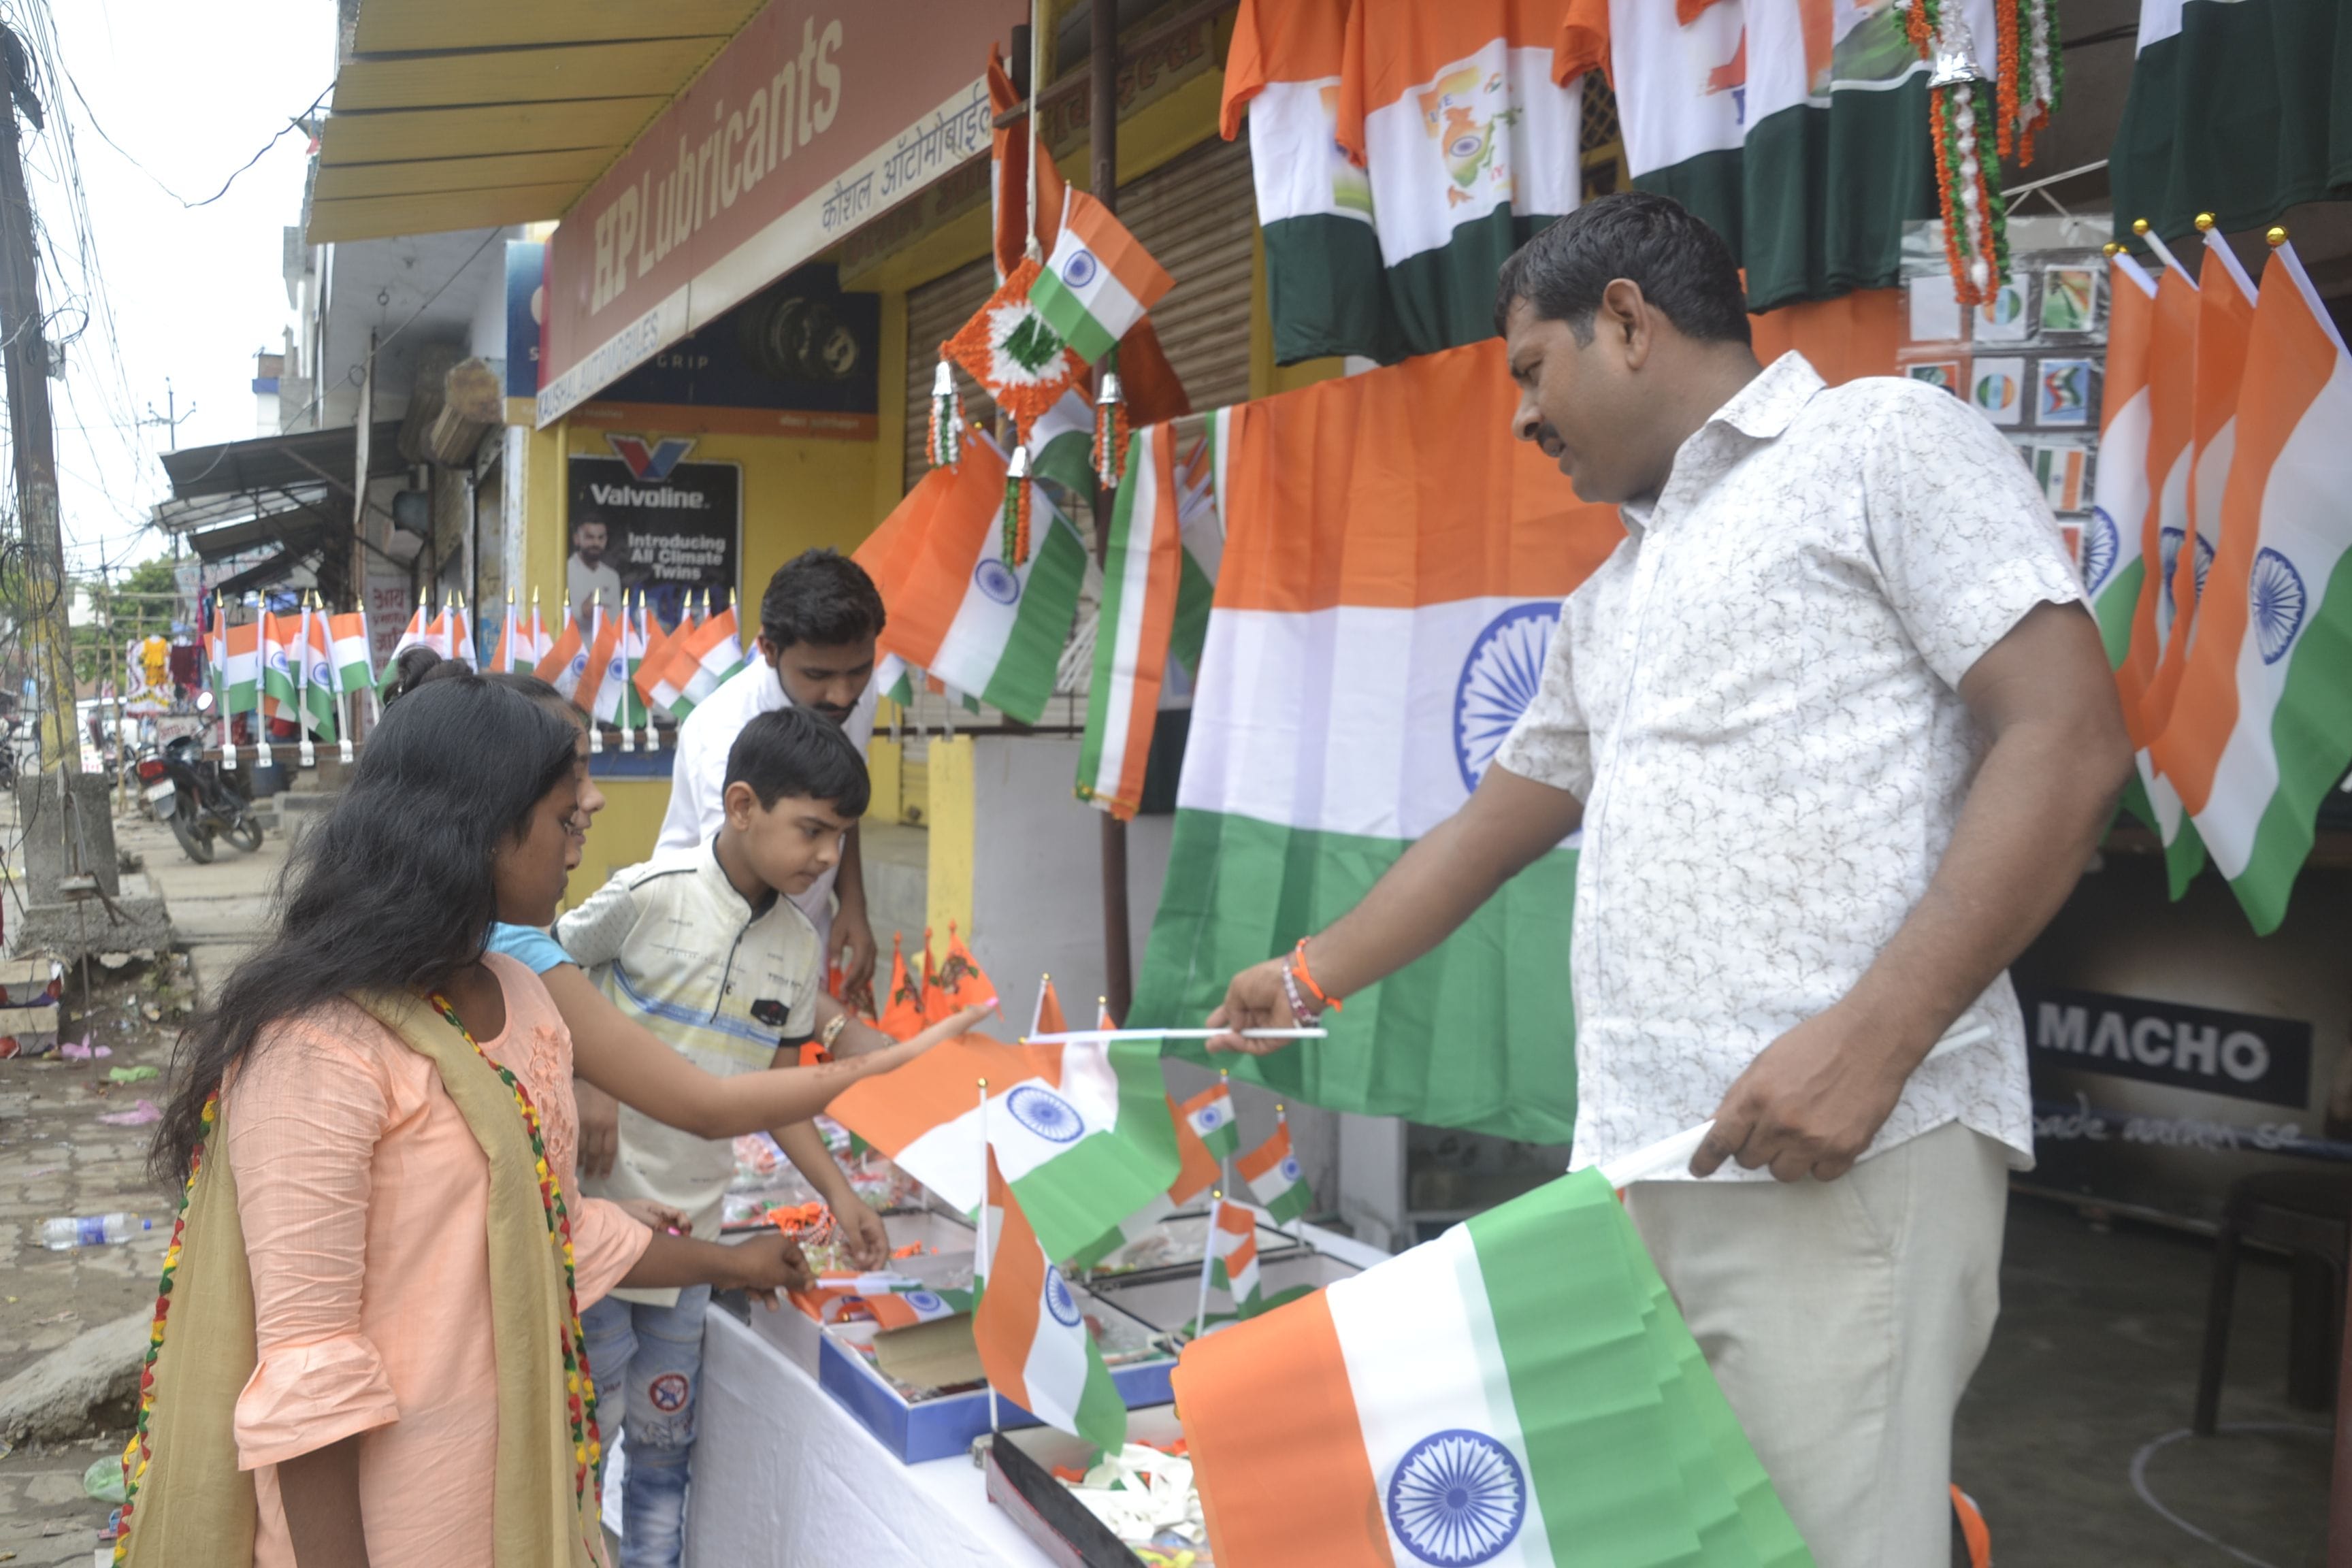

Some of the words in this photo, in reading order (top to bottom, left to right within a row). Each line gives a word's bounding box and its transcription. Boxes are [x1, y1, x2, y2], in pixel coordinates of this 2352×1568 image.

[822, 179, 875, 233] कौशल
[881, 82, 992, 196] ऑटोमोबाईल
[657, 355, 708, 369] GRIP
[590, 483, 704, 508] Valvoline
[627, 532, 726, 553] Introducing
[631, 549, 653, 564] All
[658, 549, 723, 566] Climate
[652, 564, 702, 581] Twins
[2037, 1004, 2270, 1081] MACHO
